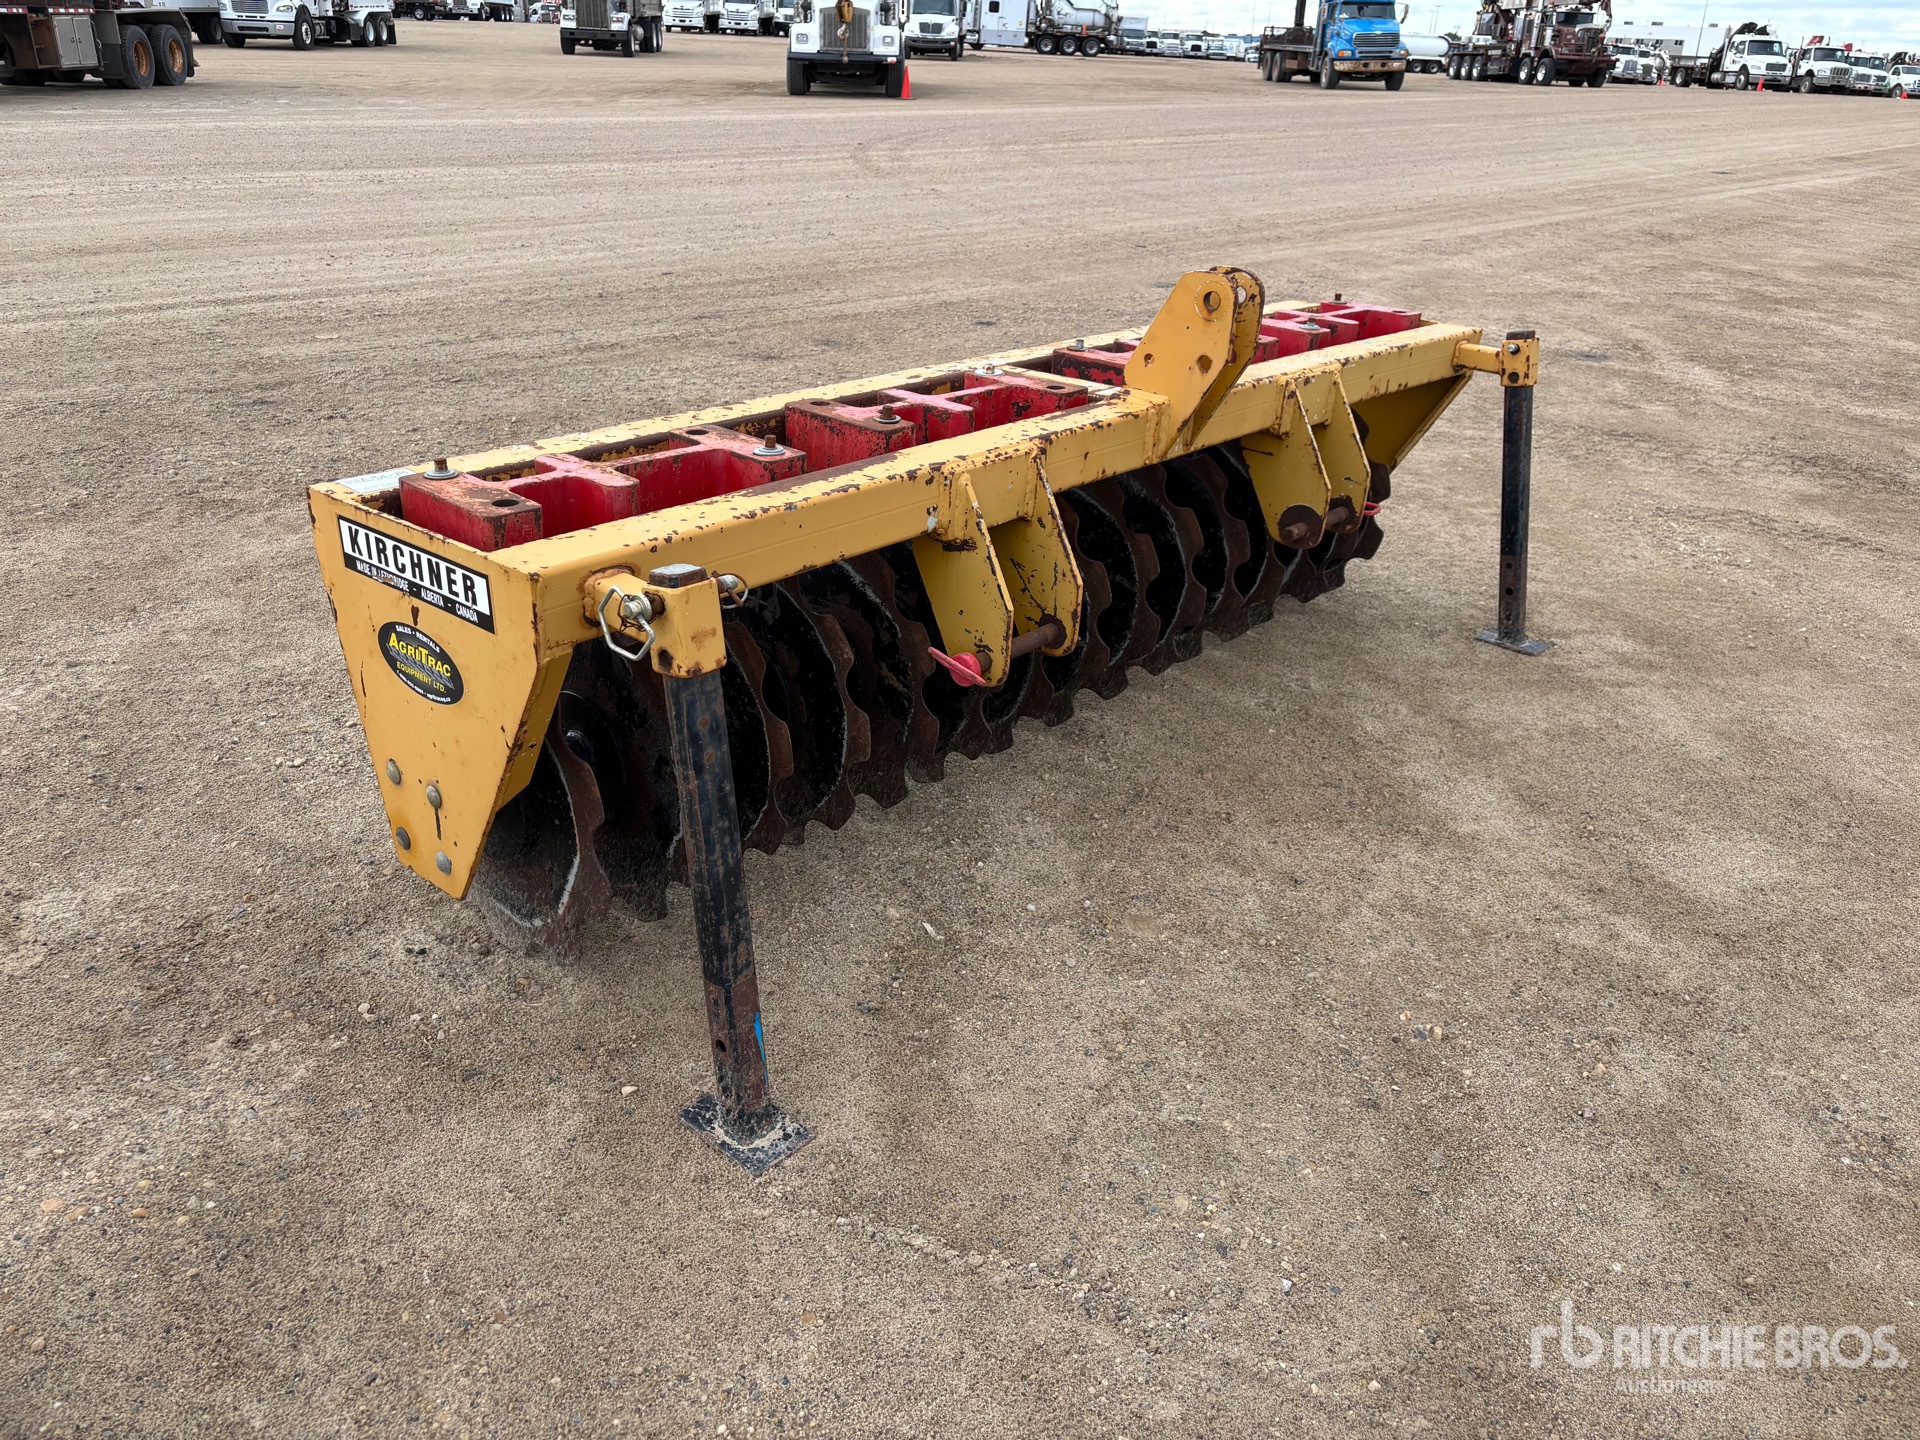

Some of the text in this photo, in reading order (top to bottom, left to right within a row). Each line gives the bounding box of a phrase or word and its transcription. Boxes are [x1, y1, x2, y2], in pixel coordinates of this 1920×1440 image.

[348, 525, 478, 606] KIRCHNER
[356, 560, 371, 576] MADE
[420, 587, 444, 608] ALBERTA
[455, 603, 478, 623] CANADA
[395, 625, 440, 653] SALES RENTALS
[397, 661, 432, 685] EQUIPMENT
[433, 680, 447, 694] LTD.
